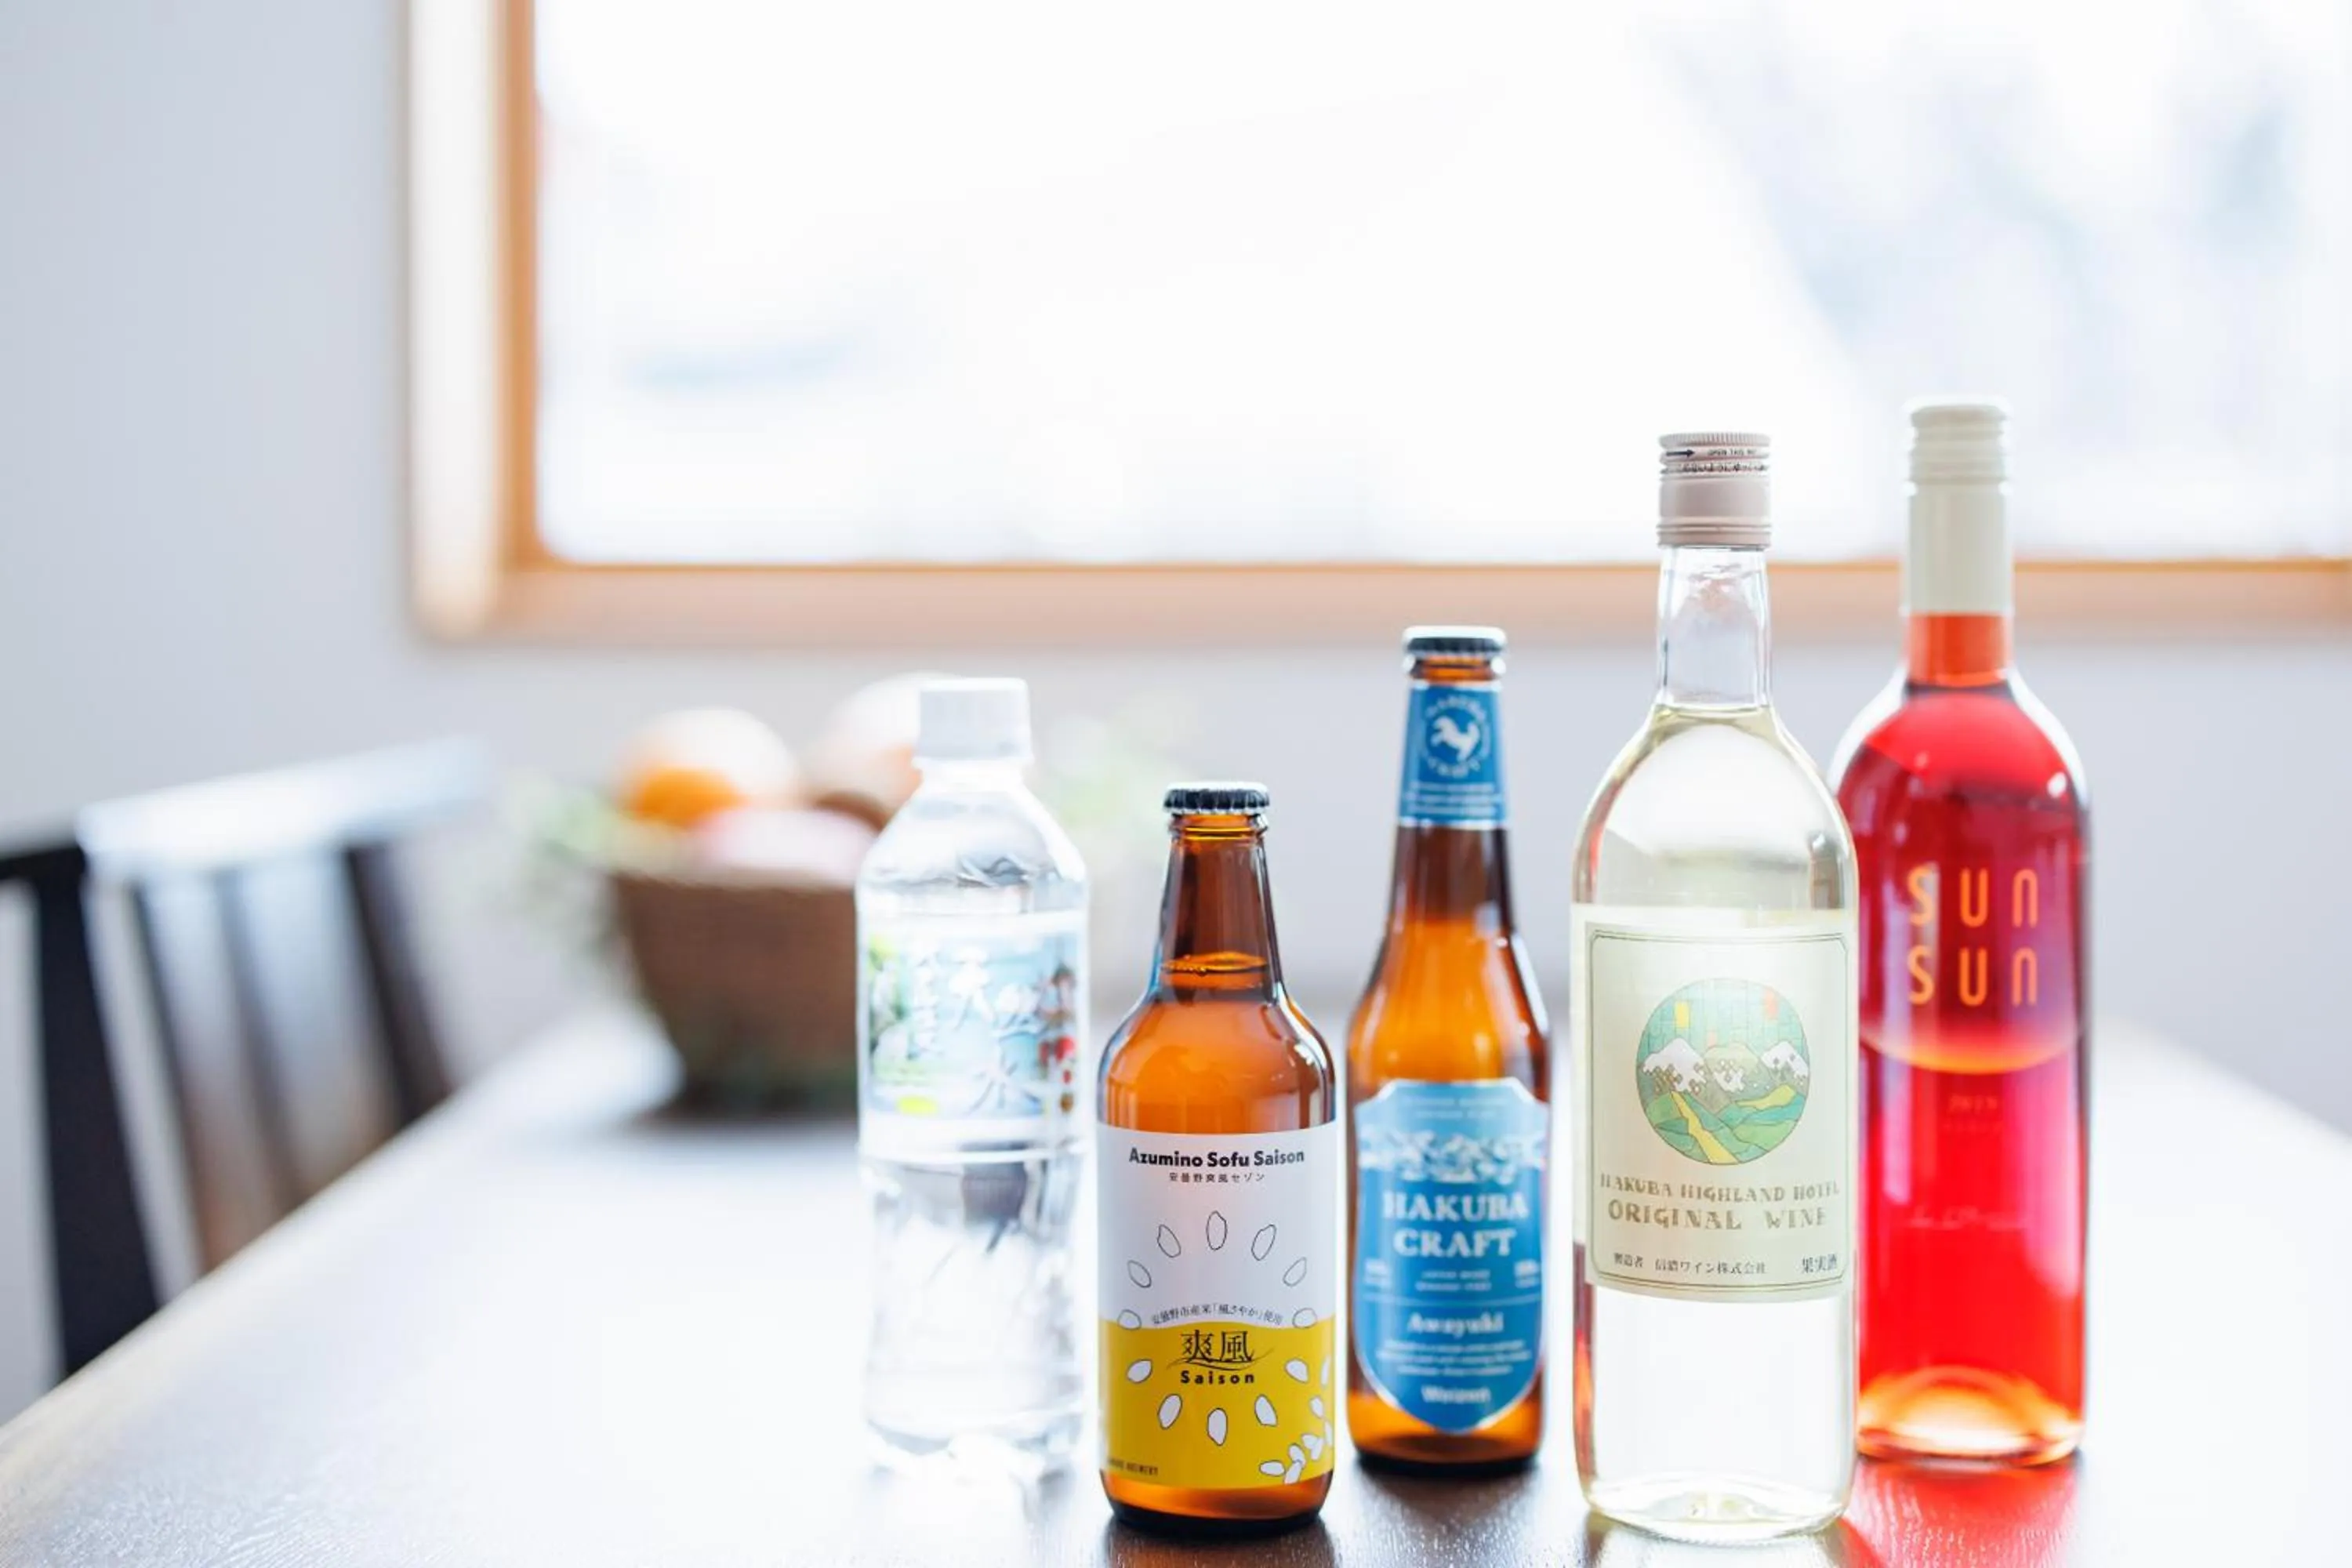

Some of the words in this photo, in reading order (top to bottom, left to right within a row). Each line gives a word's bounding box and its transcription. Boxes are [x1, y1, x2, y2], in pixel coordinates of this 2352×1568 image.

[1128, 1147, 1203, 1167] Azumino
[1207, 1151, 1250, 1167] Sofu
[1254, 1149, 1305, 1167] Saison
[1600, 1174, 1673, 1196] HAKUBA
[1680, 1184, 1787, 1203] HIGHLAND
[1793, 1180, 1840, 1201] HOTEL
[1382, 1191, 1529, 1221] HAKUBA
[1608, 1199, 1742, 1230] ORIGINAL
[1765, 1207, 1828, 1229] WINE
[1392, 1228, 1517, 1258] CRAFT
[1179, 1330, 1255, 1364] 爽風
[1181, 1370, 1254, 1385] Saison
